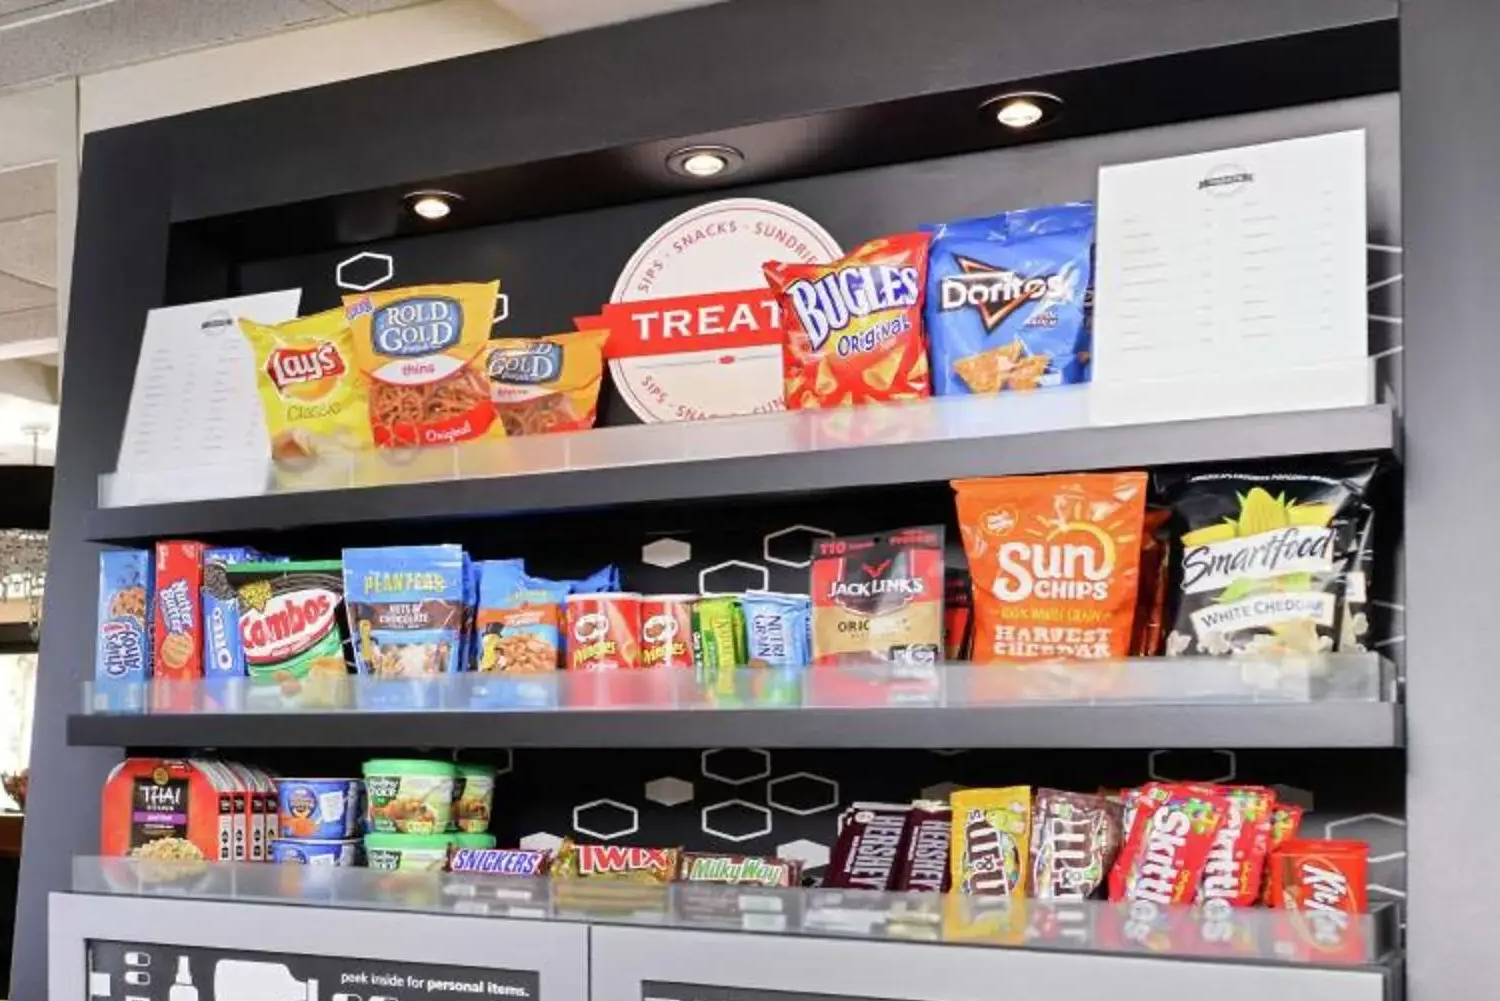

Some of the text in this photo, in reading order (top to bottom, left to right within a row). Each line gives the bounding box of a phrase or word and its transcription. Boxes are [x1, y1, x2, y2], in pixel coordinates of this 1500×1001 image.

[637, 259, 664, 294] SIPS
[671, 219, 738, 254] SNACKS
[940, 271, 1073, 310] Doritos
[387, 300, 453, 326] ROLD
[786, 266, 919, 351] BUGLES
[379, 321, 453, 352] GOLD
[272, 340, 338, 387] Lay's
[488, 354, 553, 380] GOLD
[992, 540, 1115, 602] Sun
[1180, 527, 1338, 590] Smartfood
[173, 579, 194, 627] Nutter
[827, 581, 871, 598] JACK
[1034, 580, 1110, 600] CHIPS
[160, 588, 184, 635] Butter
[239, 595, 332, 650] Combos
[1199, 604, 1250, 628] WHITE
[994, 624, 1113, 643] HARVEST
[102, 630, 127, 677] Chips
[138, 784, 181, 806] THAI
[450, 848, 542, 875] SNICKERS
[573, 845, 669, 874] TWIX
[689, 857, 785, 886] Milky Way
[1123, 806, 1191, 942] Skittles
[340, 971, 530, 998] peek inside for personal items.
